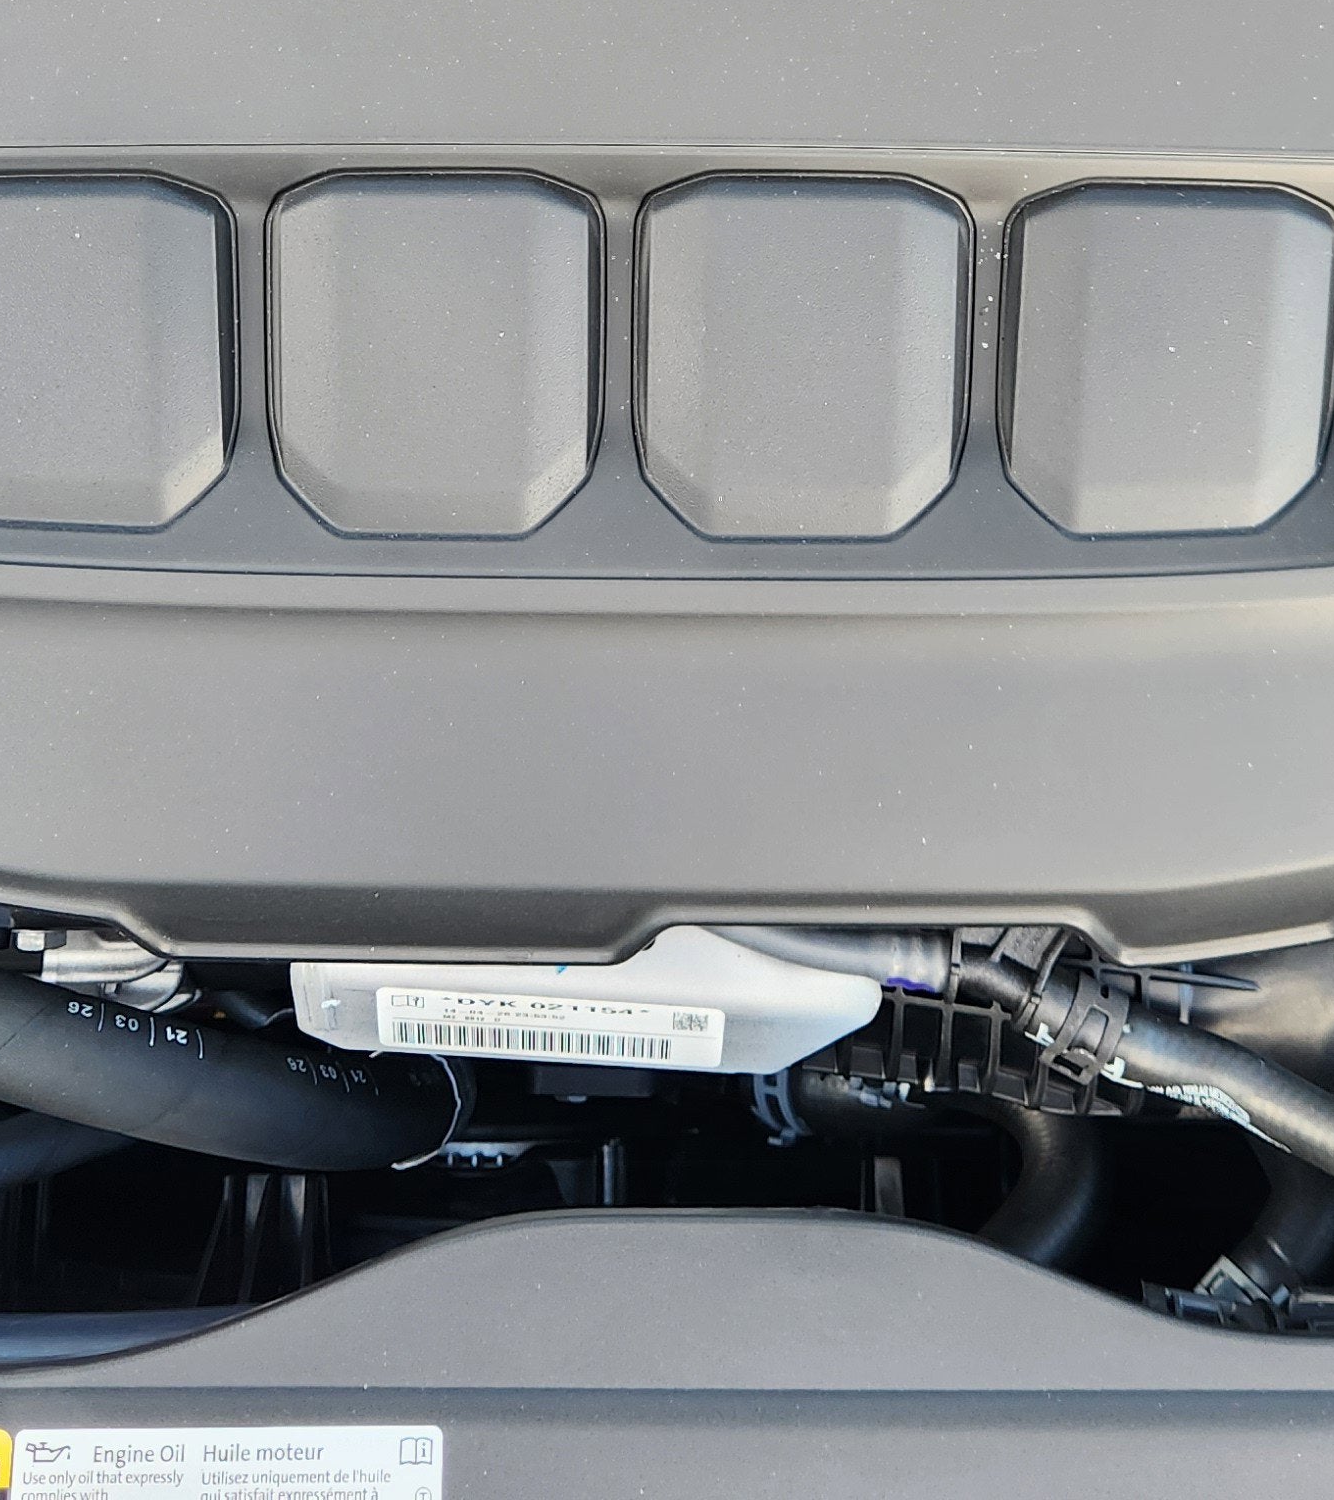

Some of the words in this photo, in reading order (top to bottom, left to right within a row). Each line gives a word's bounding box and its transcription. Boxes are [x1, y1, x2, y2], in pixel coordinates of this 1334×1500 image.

[67, 1000, 94, 1018] 26
[114, 1013, 140, 1032] 03
[165, 1025, 189, 1046] 21
[93, 1444, 155, 1468] Engine
[159, 1444, 185, 1462] Oil
[203, 1443, 251, 1462] Huile
[256, 1444, 325, 1462] moteur
[22, 1472, 46, 1485] Use
[48, 1470, 77, 1488] only
[78, 1470, 94, 1484] oil
[97, 1470, 123, 1484] that
[125, 1469, 185, 1487] expressly
[201, 1470, 249, 1485] Utilisez
[251, 1469, 331, 1487] uniquement
[333, 1469, 350, 1483] de
[352, 1469, 392, 1483] l'huile
[20, 1488, 77, 1500] complies
[80, 1488, 109, 1500] with
[224, 1487, 274, 1500] satisfait
